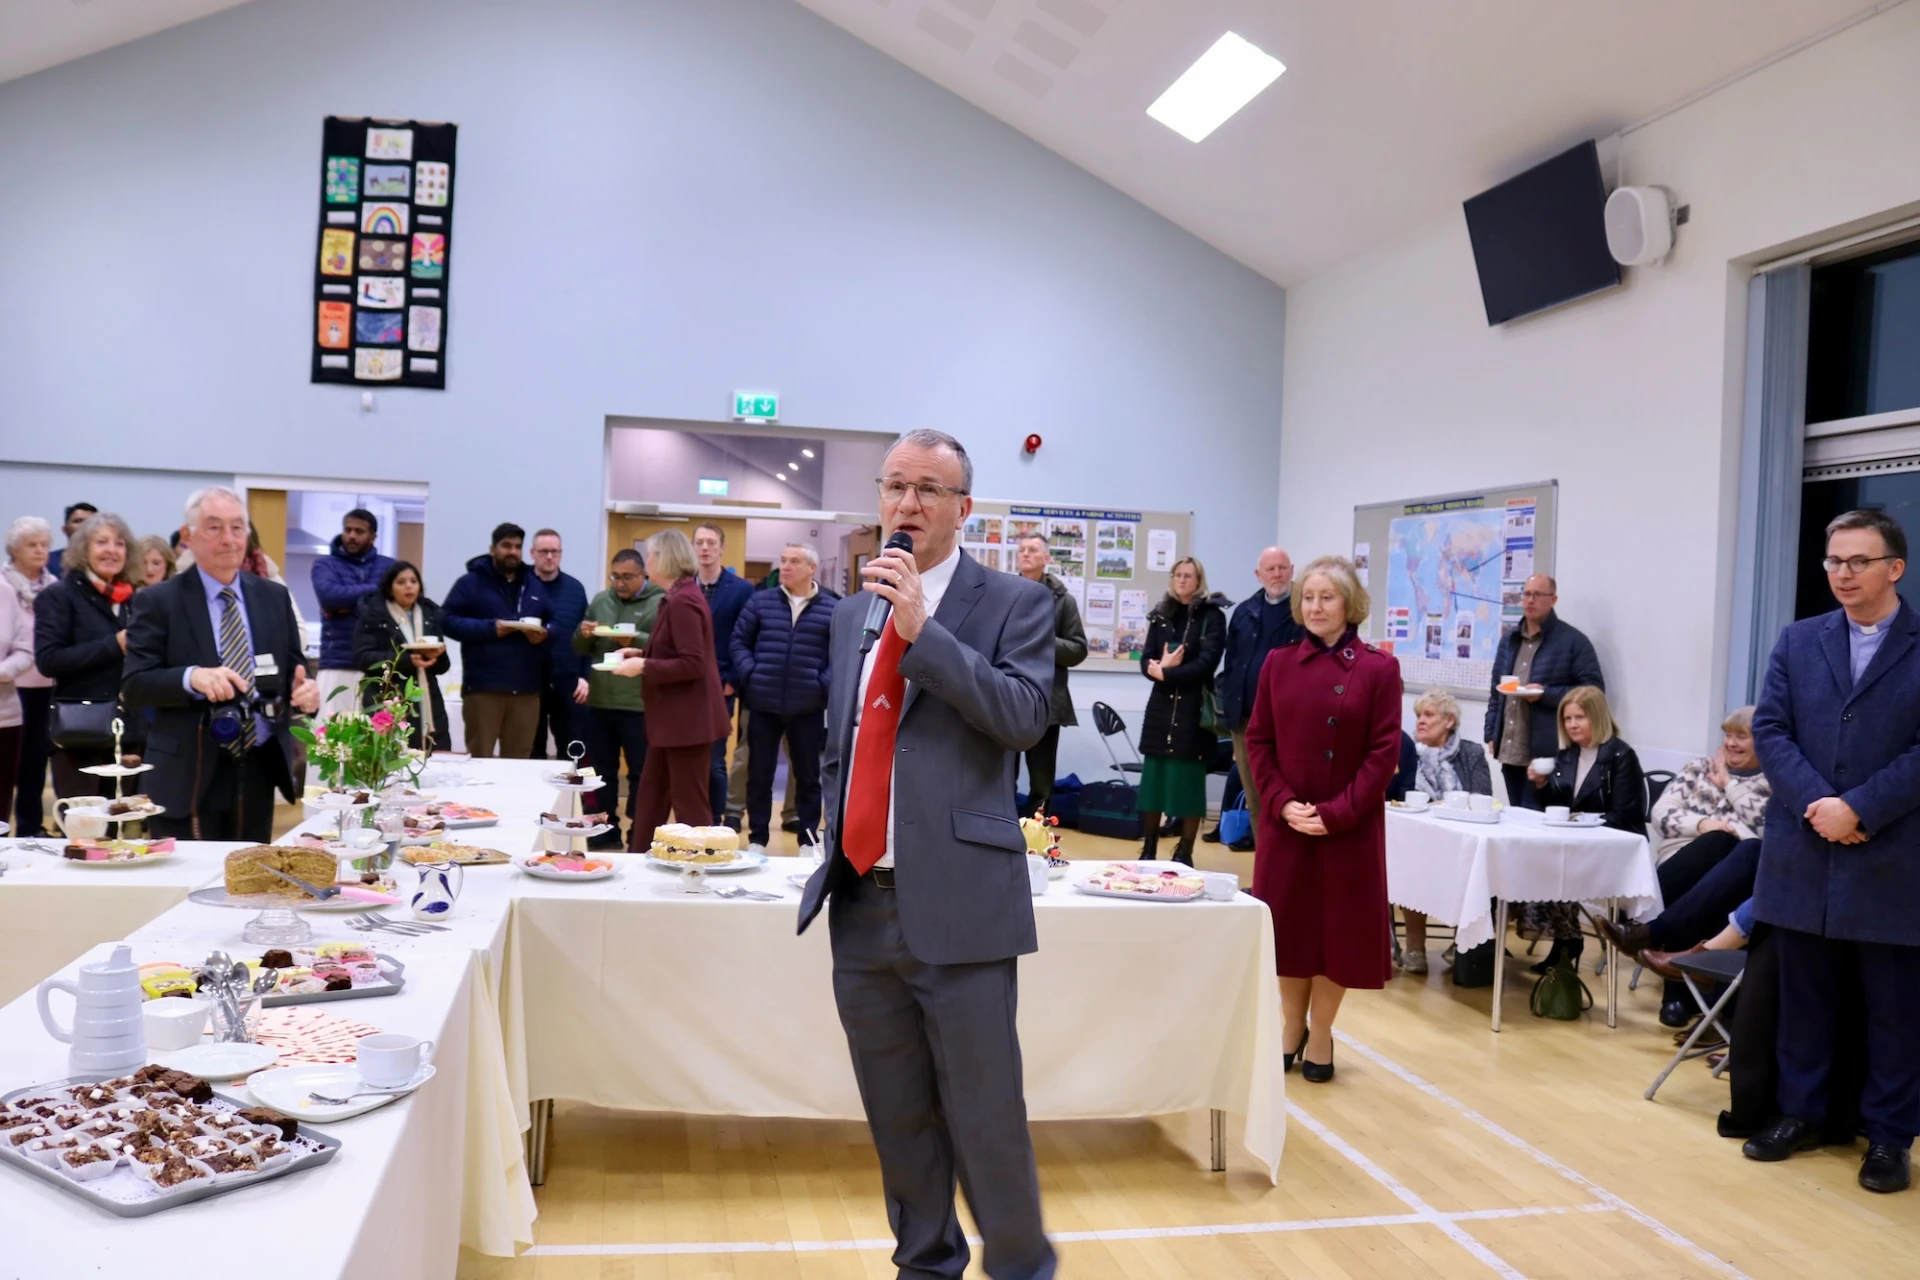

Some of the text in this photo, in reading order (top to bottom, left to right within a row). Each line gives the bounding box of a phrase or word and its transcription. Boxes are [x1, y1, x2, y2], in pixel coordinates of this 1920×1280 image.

[1011, 506, 1041, 514] WORSHIP
[1043, 508, 1073, 516] SERVICES
[1106, 512, 1140, 520] ACTIVITIES
